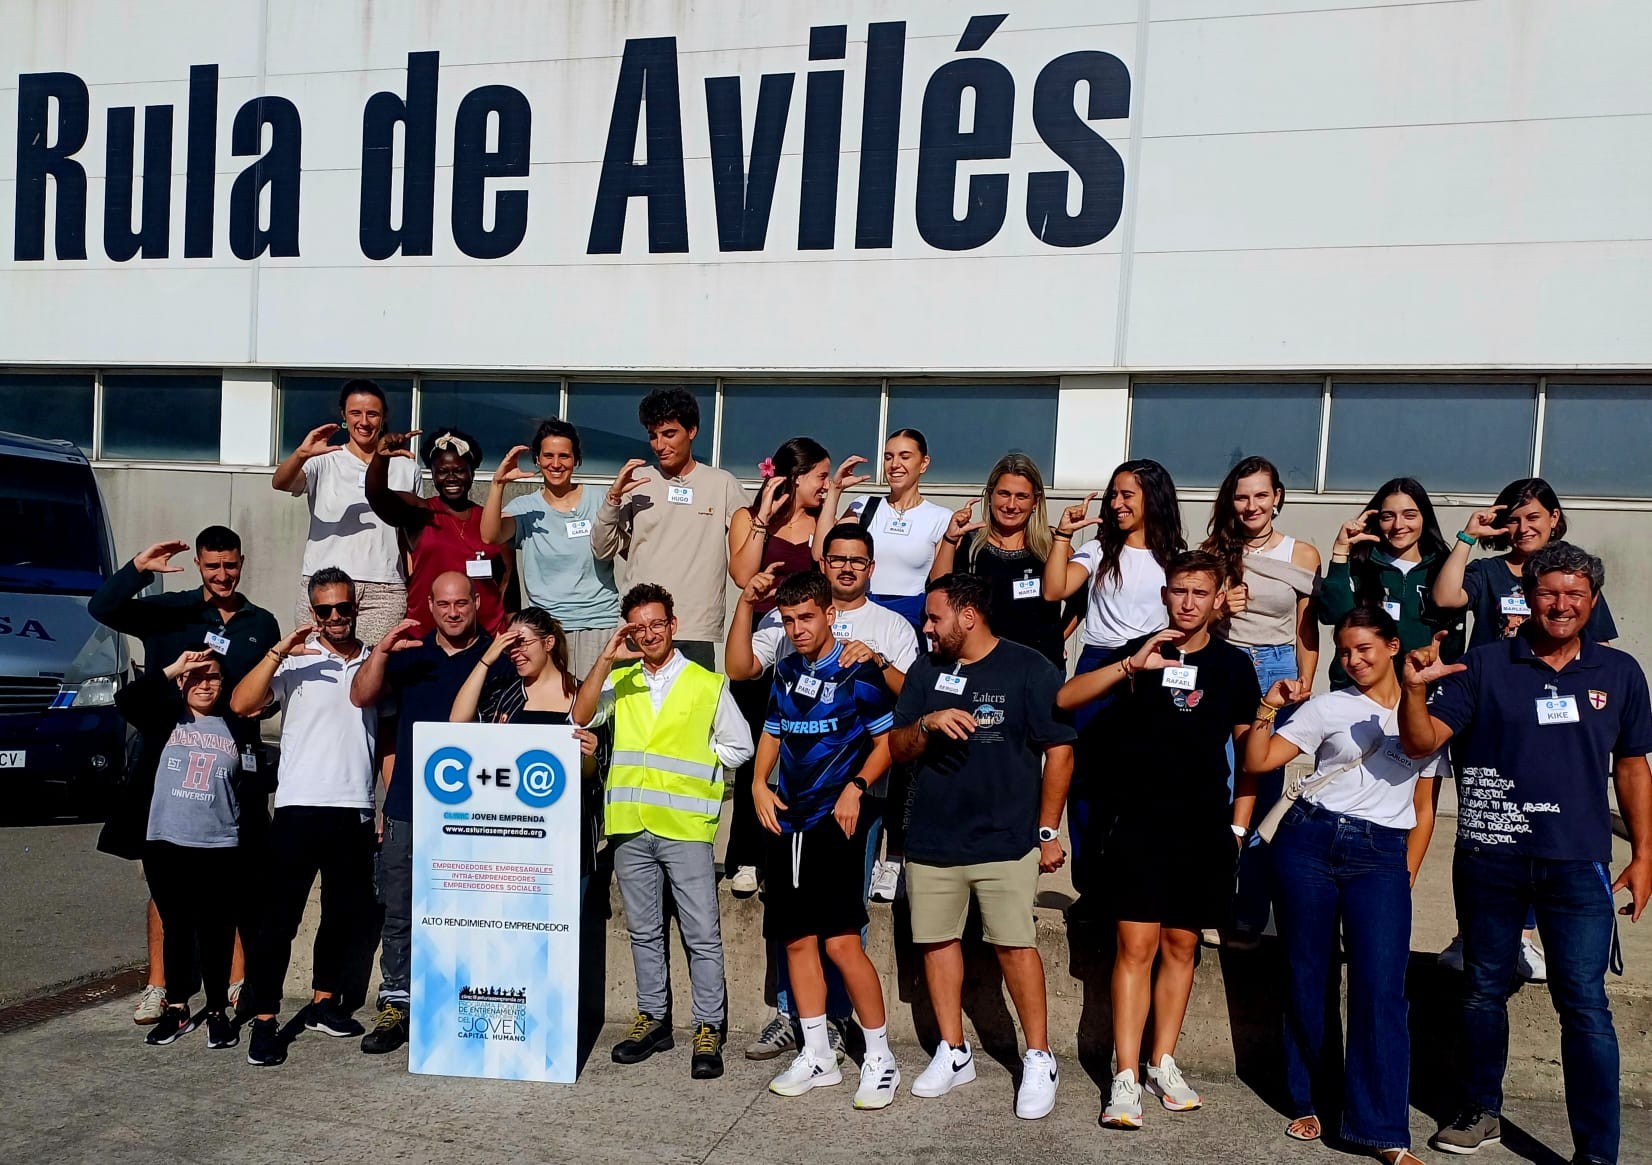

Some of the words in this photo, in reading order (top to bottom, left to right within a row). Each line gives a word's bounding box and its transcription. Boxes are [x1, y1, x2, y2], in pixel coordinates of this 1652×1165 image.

[14, 63, 302, 261] Rula
[359, 51, 532, 261] de
[586, 14, 1131, 255] Avilés
[1166, 677, 1192, 687] RAFAEL
[798, 685, 816, 696] PABLO
[972, 691, 1006, 703] Lakers
[1547, 711, 1569, 720] KIKE
[0, 753, 18, 766] CV
[1386, 750, 1413, 767] CARLOTA
[182, 751, 217, 791] H
[171, 787, 217, 802] UNIVERSITY
[471, 812, 498, 822] JOVEN
[499, 814, 545, 824] EMPRENDA
[445, 825, 543, 837] www.asturiasemprenda.org
[432, 862, 493, 872] EMPRENDEDORES
[495, 865, 553, 874] EMPRESARIALES
[451, 872, 536, 883] INTRA-EMPRENDEDORES
[443, 881, 504, 891] EMPRENDEDORES
[506, 884, 542, 893] SOCIALES
[421, 916, 443, 926] ALTO
[444, 917, 503, 929] RENDIMIENTO
[504, 921, 569, 933] EMPRENDEDOR
[470, 1007, 526, 1016] ENTRENAMIENTO
[458, 1016, 471, 1024] DEL
[462, 1017, 526, 1035] JOVEN
[457, 1032, 489, 1040] CAPITAL
[492, 1034, 526, 1042] HUMANO
